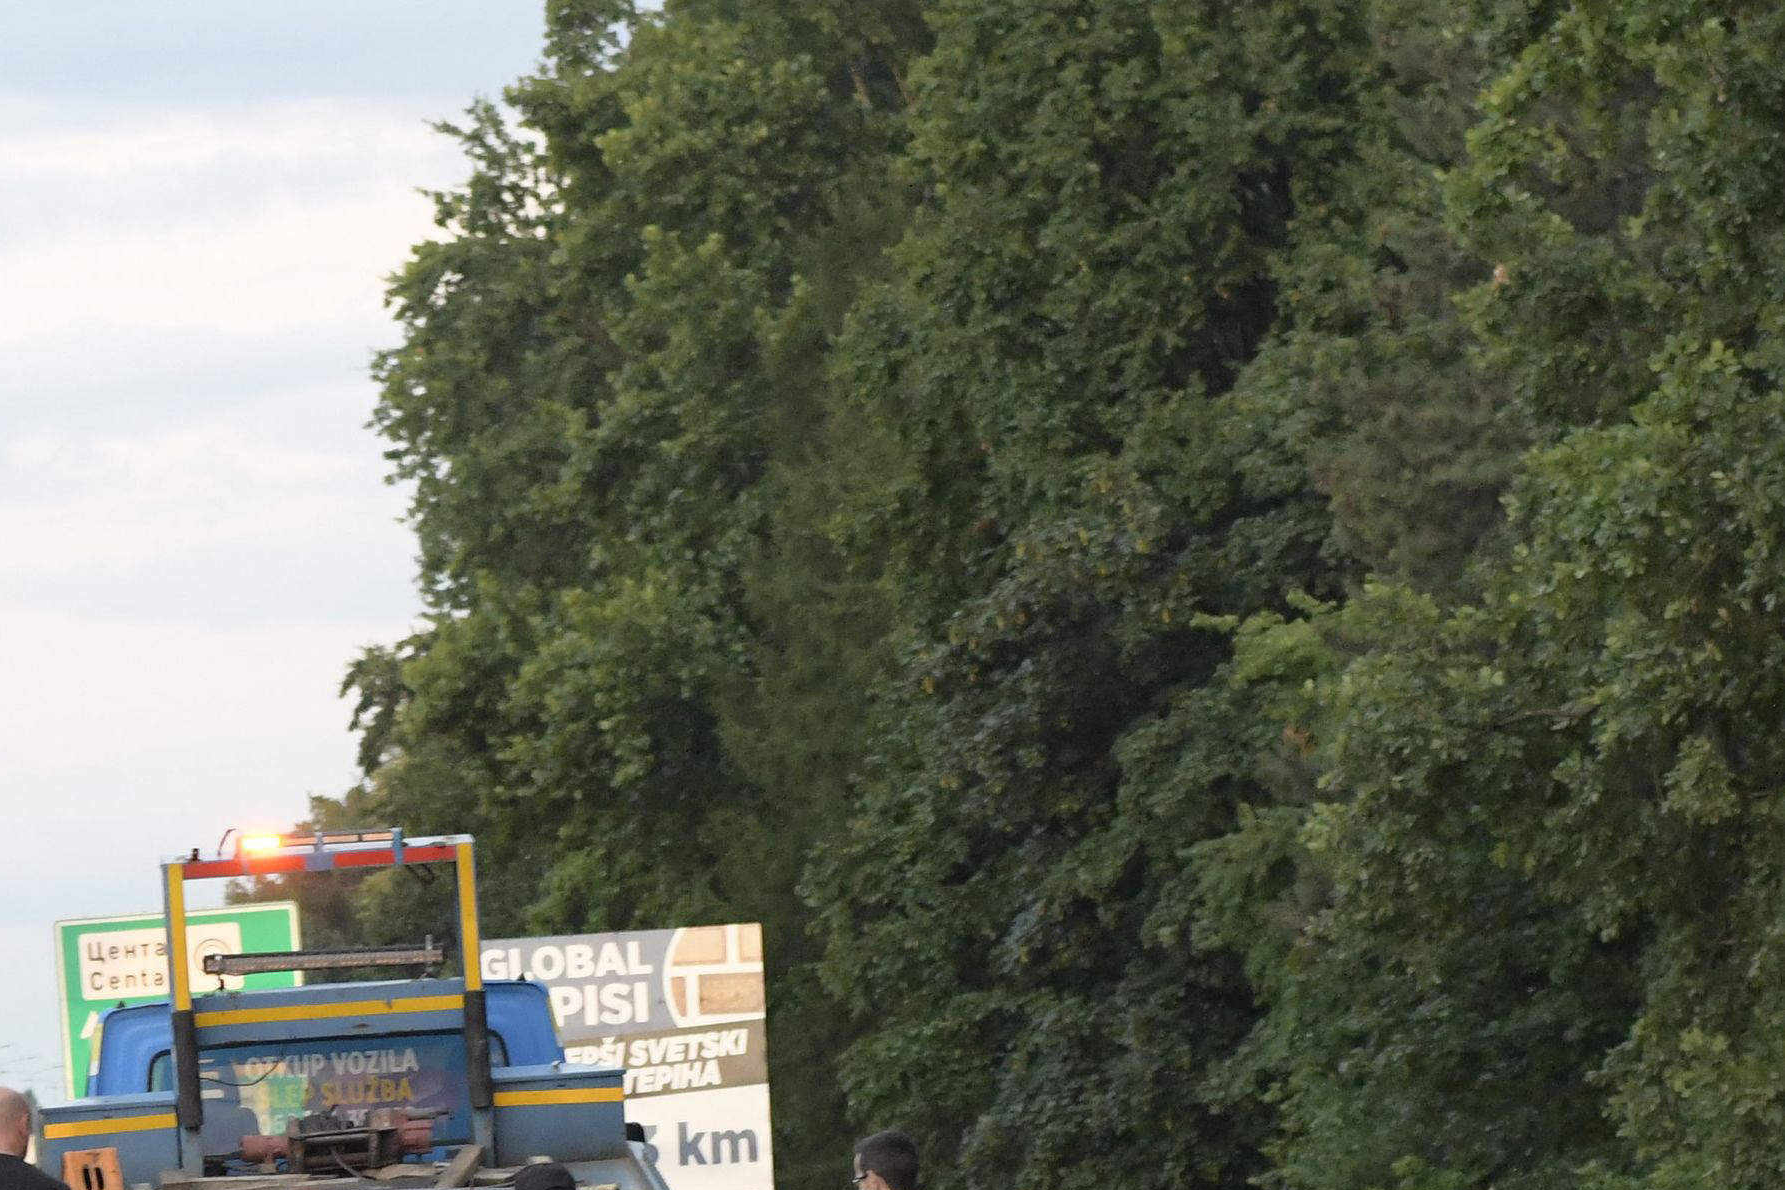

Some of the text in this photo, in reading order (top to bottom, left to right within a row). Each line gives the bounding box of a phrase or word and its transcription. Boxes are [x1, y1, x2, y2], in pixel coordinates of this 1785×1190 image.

[87, 942, 168, 962] Цента
[480, 942, 653, 981] GLOBAL
[90, 971, 164, 991] Centa
[549, 982, 649, 1027] PISI
[331, 1050, 418, 1075] VOZILA
[565, 1029, 749, 1068] EPŠI SVETSKI
[623, 1060, 722, 1095] TEPIHA
[678, 1122, 758, 1166] km
